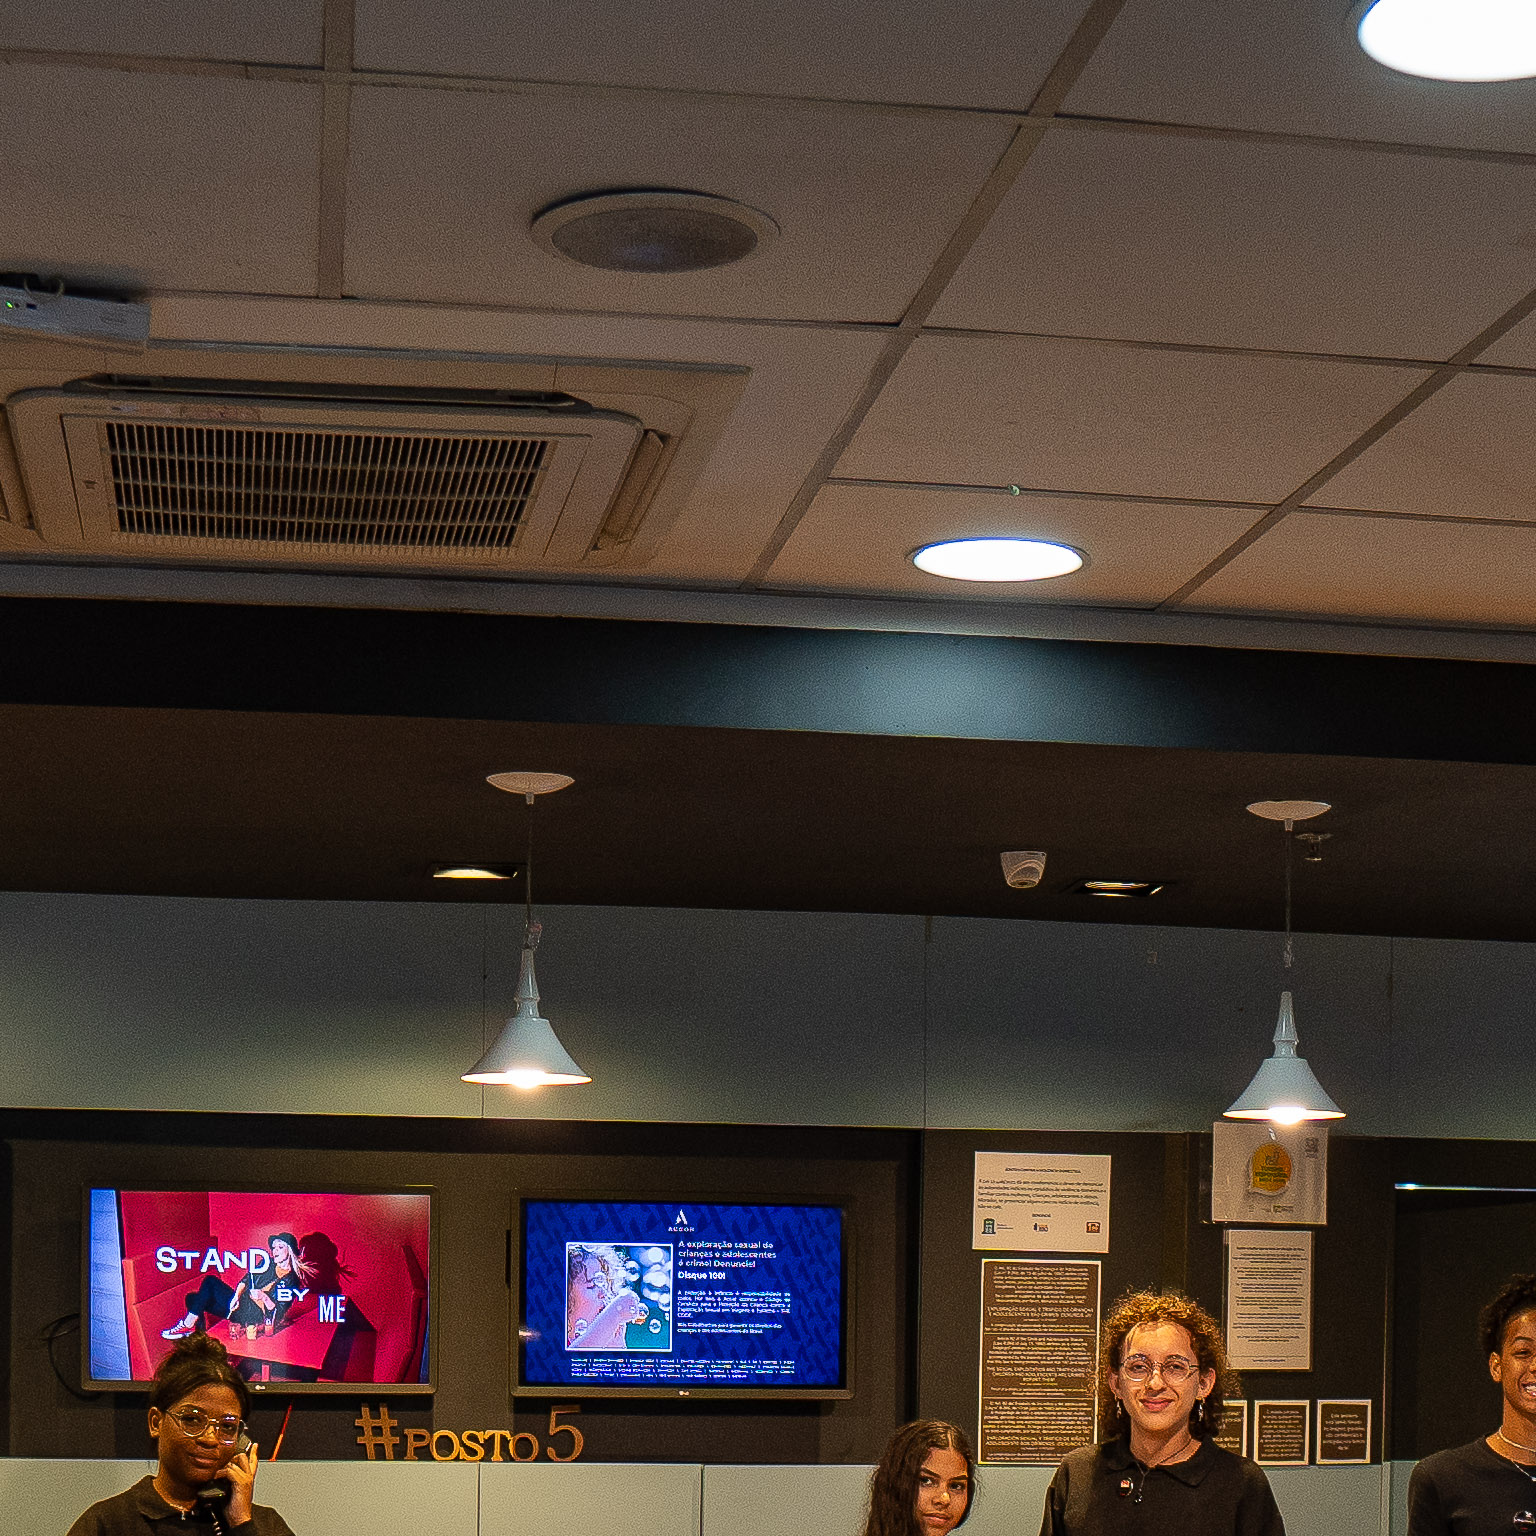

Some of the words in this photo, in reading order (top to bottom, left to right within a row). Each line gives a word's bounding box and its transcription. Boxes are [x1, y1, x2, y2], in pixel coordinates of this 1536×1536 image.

[155, 1246, 271, 1275] STAND
[277, 1287, 310, 1302] BY
[318, 1294, 347, 1324] ME
[677, 1270, 708, 1281] Disque
